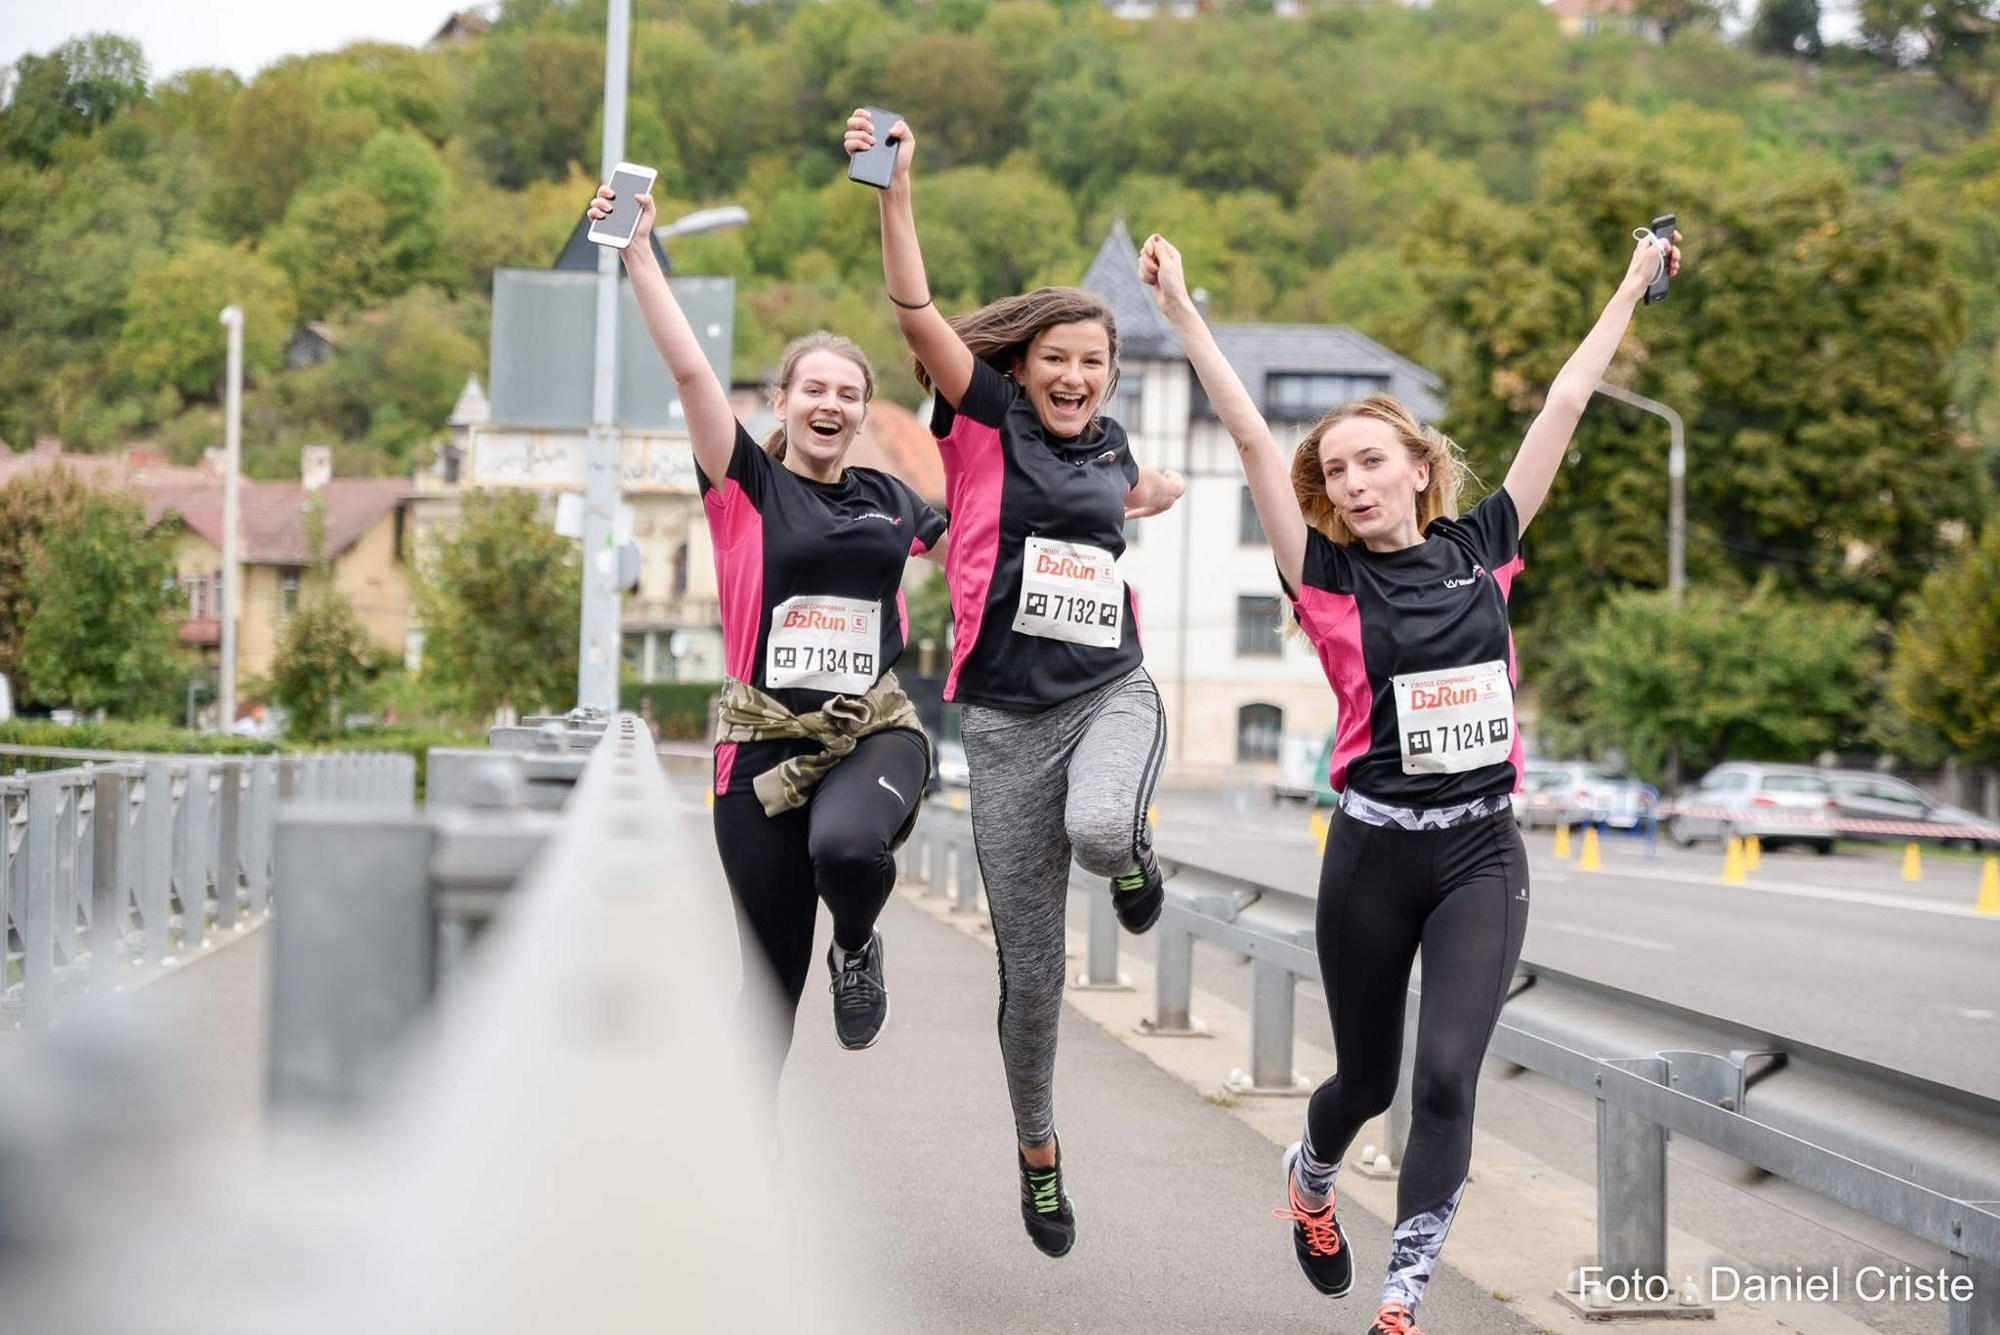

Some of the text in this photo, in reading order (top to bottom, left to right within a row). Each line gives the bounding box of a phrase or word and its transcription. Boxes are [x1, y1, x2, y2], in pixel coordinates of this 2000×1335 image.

[1036, 554, 1096, 580] B2Run
[783, 610, 846, 631] B2Run
[1053, 594, 1096, 625] 7132
[803, 647, 848, 674] 7134
[1411, 686, 1477, 711] B2Run
[1437, 721, 1485, 753] 7124
